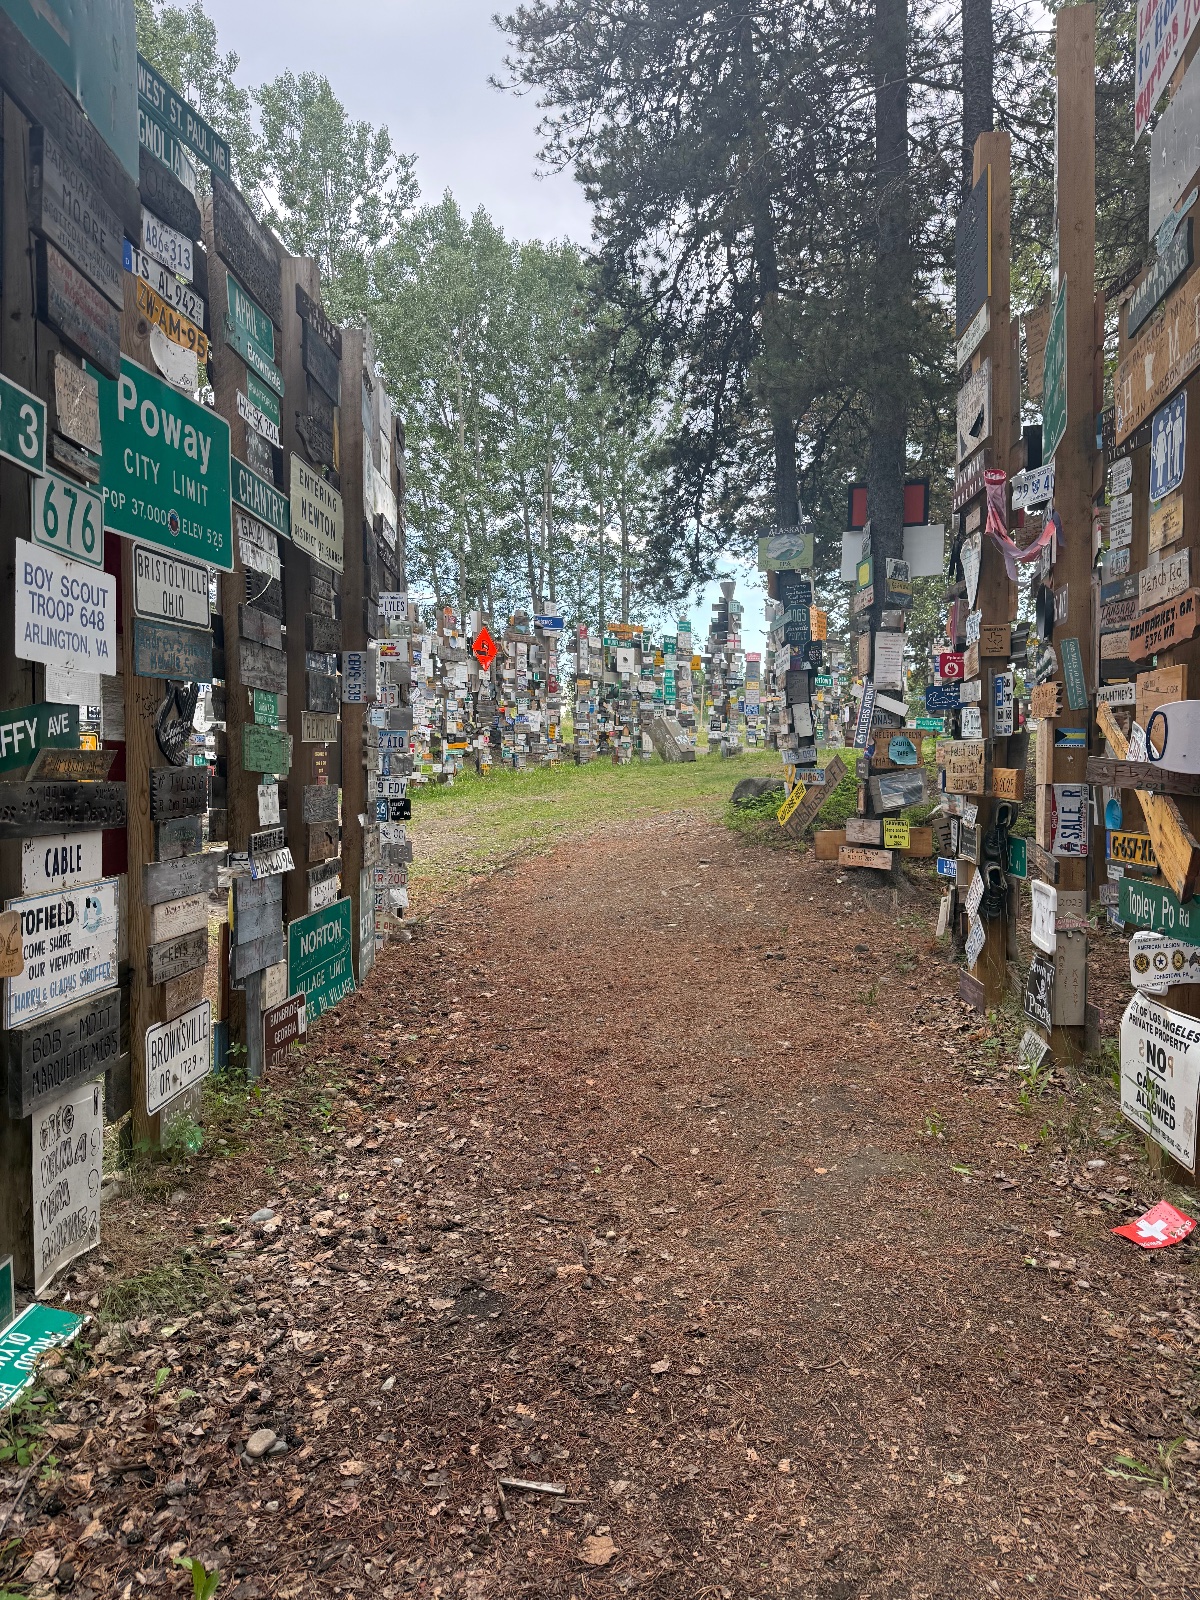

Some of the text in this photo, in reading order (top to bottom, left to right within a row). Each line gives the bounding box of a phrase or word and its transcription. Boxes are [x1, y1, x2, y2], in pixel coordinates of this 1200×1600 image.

[137, 62, 166, 112] WEST
[169, 102, 184, 132] ST.
[187, 112, 210, 158] PAUL
[138, 110, 181, 180] GNOLIA
[170, 239, 191, 270] 313
[132, 248, 150, 281] TS
[158, 271, 173, 302] AL
[175, 287, 196, 320] 942
[1153, 248, 1187, 303] IDAHO
[235, 289, 260, 341] APRIL
[118, 373, 212, 475] Poway
[1126, 402, 1147, 428] JOHN
[124, 448, 209, 507] CITY LIMIT
[299, 467, 337, 513] ENTERING
[43, 479, 96, 554] 676
[102, 486, 126, 509] POP
[131, 498, 167, 527] 37,000
[182, 518, 204, 541] ELEV
[207, 528, 224, 549] 525
[238, 469, 286, 528] CHANTRY
[301, 497, 337, 542] NEWTON
[768, 525, 808, 538] ALASKAN
[24, 562, 109, 609] BOY SCOUT
[137, 553, 208, 596] BRISTOLVILLE
[28, 590, 105, 632] TROOP 648
[162, 591, 185, 618] OHIO
[384, 600, 406, 612] LYLES
[24, 622, 91, 658] ARLINGTON,
[95, 637, 109, 658] VA
[347, 684, 362, 702] 539
[0, 712, 70, 758] FFY AVE
[872, 714, 893, 726] ONAS
[1050, 810, 1058, 829] OHIO
[1061, 789, 1081, 839] SALE R
[45, 843, 82, 878] CABLE
[20, 900, 76, 936] TOFIELD
[1058, 897, 1083, 908] 2023
[1129, 885, 1190, 929] Topley Po Rd
[23, 932, 72, 961] COME SHARE
[300, 918, 342, 958] NORTON
[1137, 943, 1162, 951] AMERICAN
[1162, 941, 1180, 949] LEGION
[28, 946, 91, 981] OUR VIEWPOINT
[296, 957, 346, 997] VILLAGE LIMIT
[14, 987, 41, 1014] HARRY
[49, 976, 77, 999] GLADYS
[328, 976, 355, 1007] VILLAGE
[33, 1027, 62, 1064] BOB
[151, 1010, 208, 1071] BROWNSVILLE
[274, 1021, 297, 1044] GEORGIA
[1128, 1013, 1191, 1055] PRIVATE PROPERTY
[1139, 1007, 1200, 1044] OF LOS ANGELES
[1146, 1040, 1168, 1074] NO
[159, 1069, 171, 1096] OR
[1136, 1090, 1176, 1131] ALLOWED
